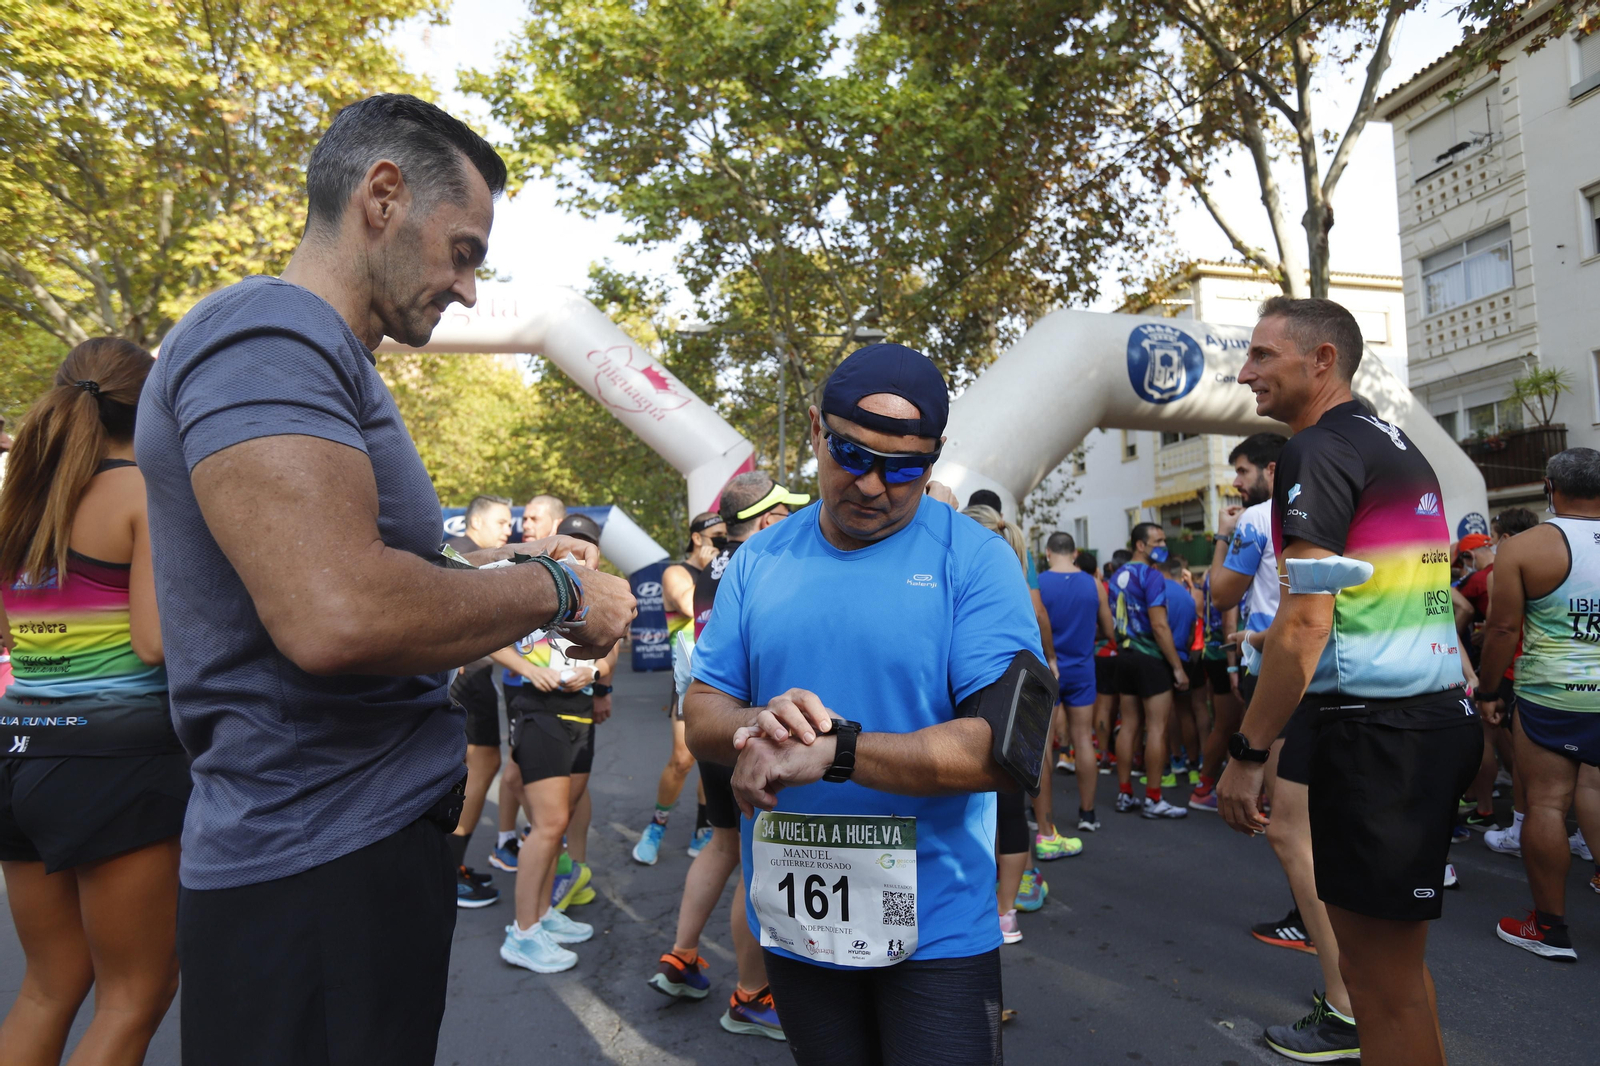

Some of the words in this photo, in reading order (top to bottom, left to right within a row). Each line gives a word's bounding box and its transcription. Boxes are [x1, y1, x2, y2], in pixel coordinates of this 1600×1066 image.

[22, 716, 88, 726] RUNNERS
[761, 821, 775, 839] 34
[779, 821, 827, 843] VUELTA
[831, 825, 842, 843] A
[846, 824, 903, 845] HUELVA
[783, 848, 832, 860] MANUEL
[770, 858, 816, 869] GUTIERREZ
[817, 862, 852, 871] ROSADO
[778, 872, 850, 922] 161
[800, 924, 853, 935] INDEPENDIENTE
[887, 949, 905, 957] RUN
